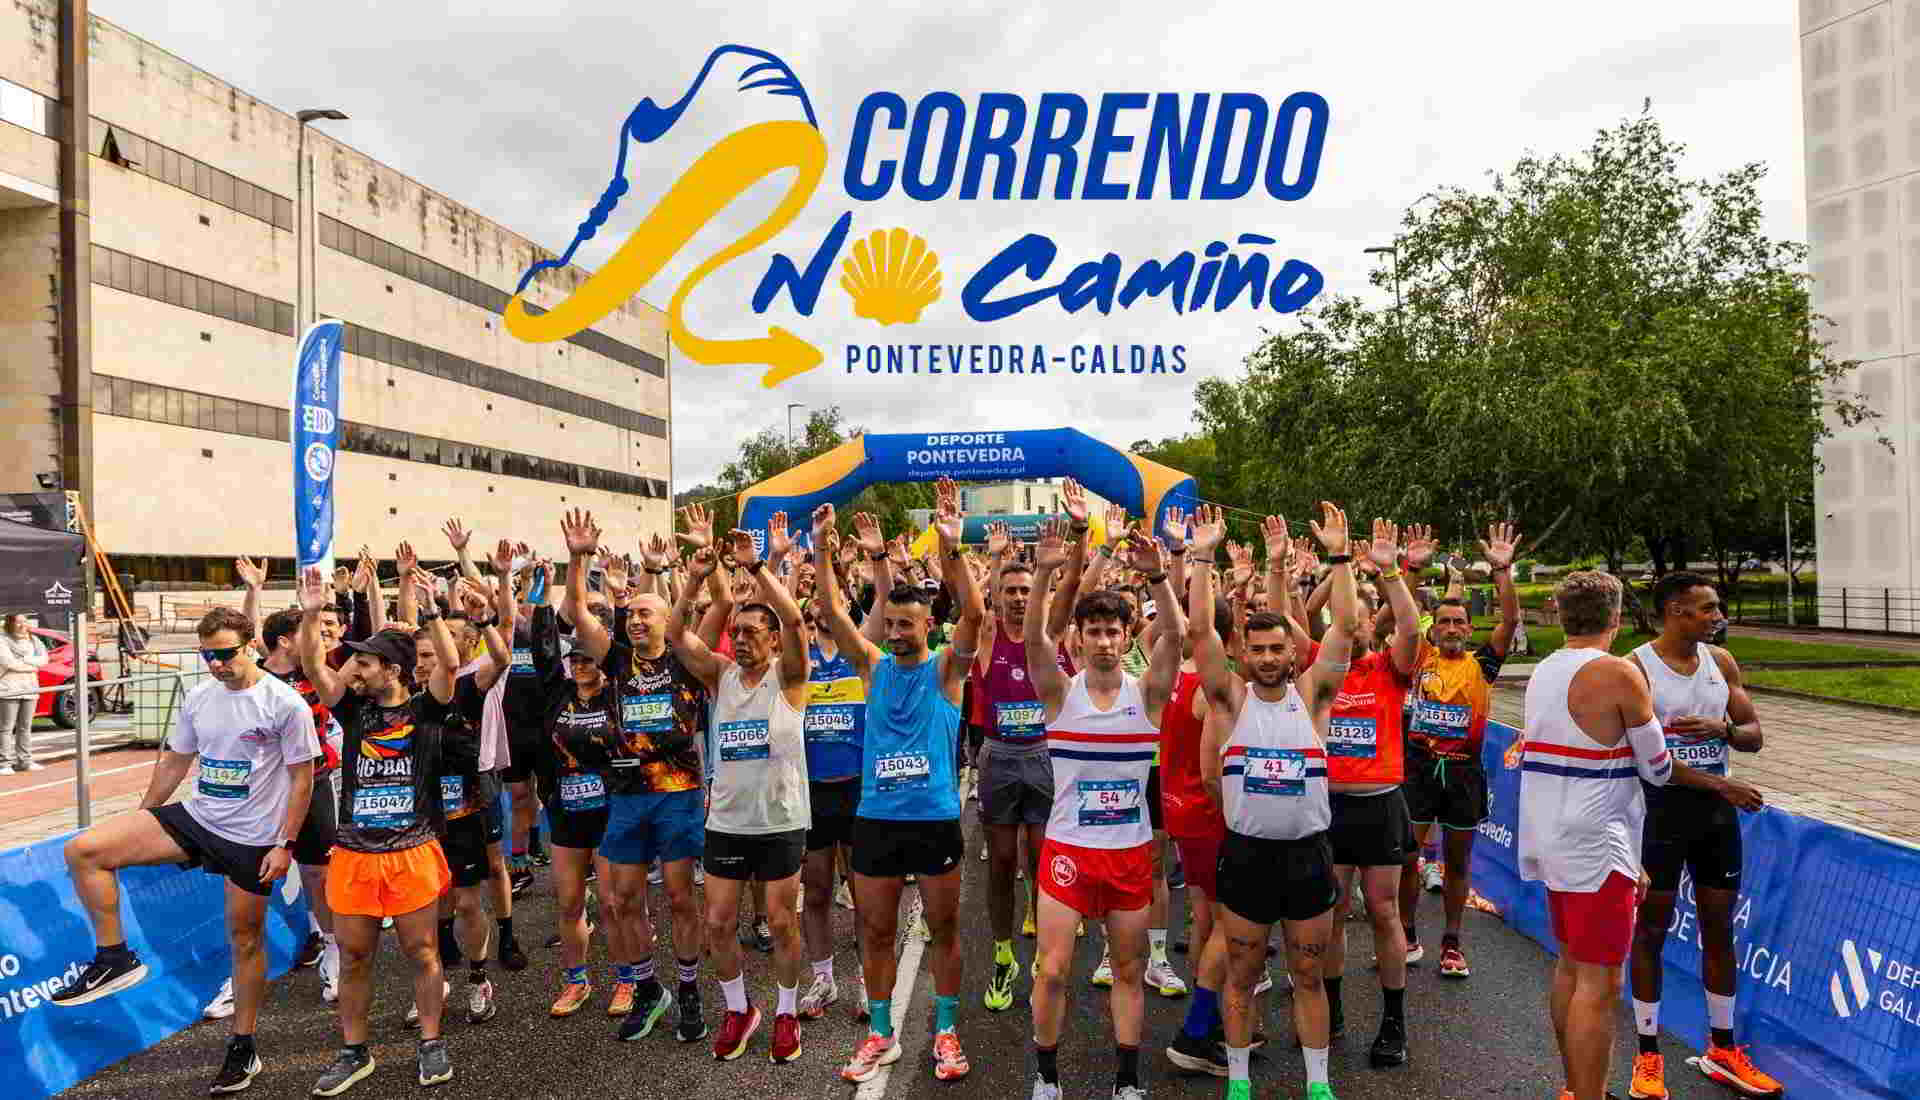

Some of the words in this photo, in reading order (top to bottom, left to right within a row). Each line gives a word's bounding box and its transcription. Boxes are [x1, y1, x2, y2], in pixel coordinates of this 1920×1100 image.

[927, 433, 1005, 447] DEPORTE
[906, 447, 1025, 465] PONTEVEDRA
[723, 729, 764, 743] 15066
[1328, 726, 1370, 739] 15128
[1669, 745, 1718, 760] 15088
[880, 757, 924, 771] 15043
[1264, 759, 1285, 773] 41
[360, 796, 408, 809] 15047
[1100, 791, 1120, 804] 54
